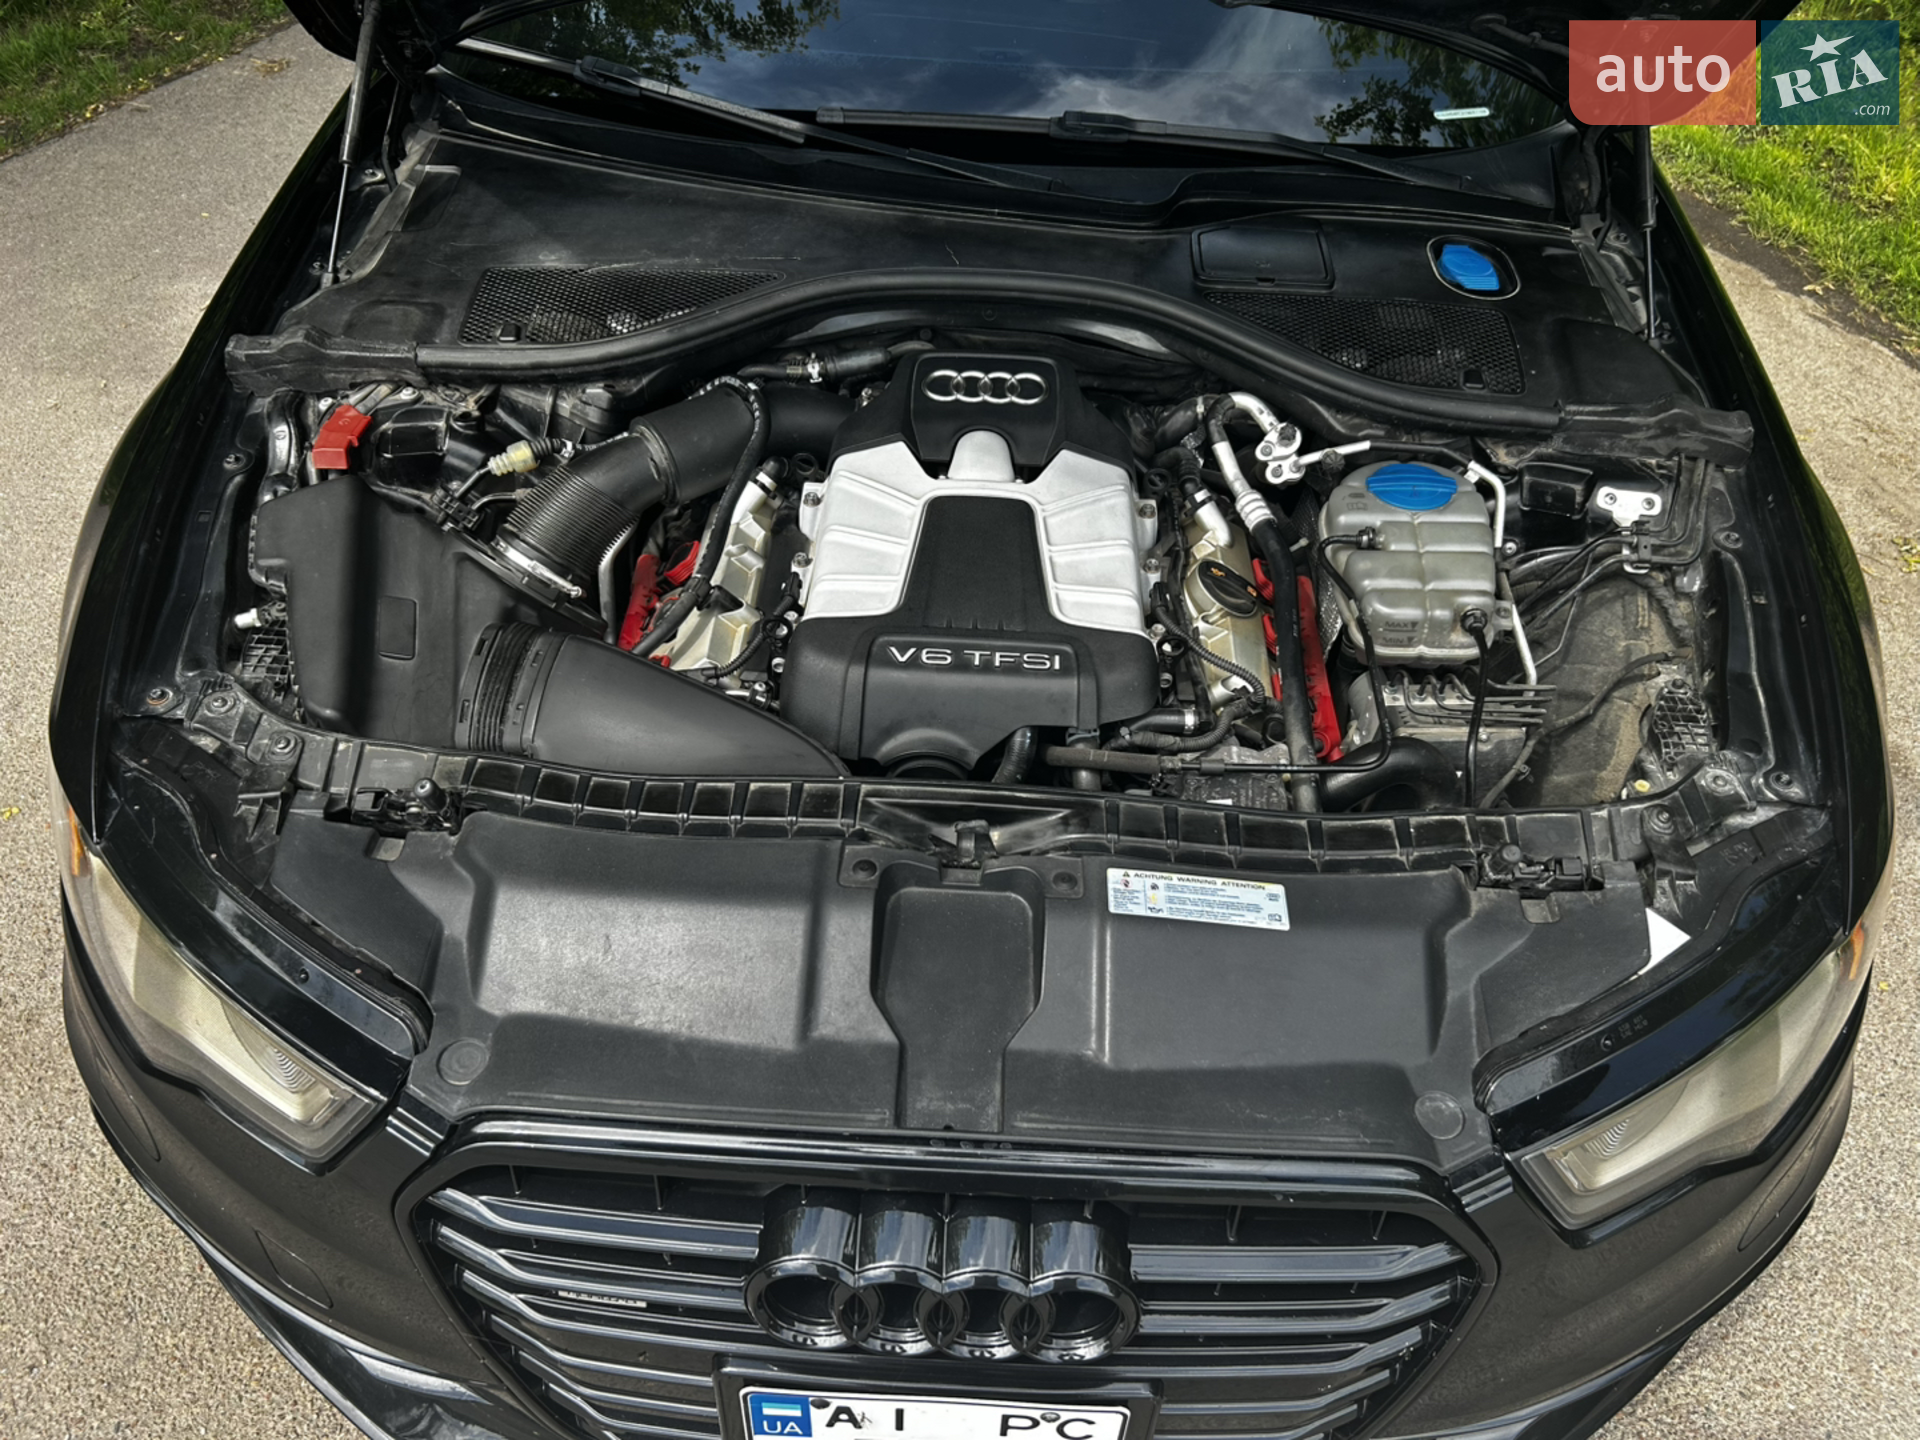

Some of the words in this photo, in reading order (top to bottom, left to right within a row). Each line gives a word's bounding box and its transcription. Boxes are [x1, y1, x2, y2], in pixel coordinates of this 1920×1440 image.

[1384, 620, 1409, 629] MAX
[1382, 636, 1405, 644] MIN
[888, 646, 953, 665] V6
[963, 649, 1061, 671] TFSI
[1133, 872, 1174, 882] ACHTUNG
[1177, 877, 1217, 887] WARNING
[1221, 880, 1266, 891] ATTENTION
[763, 1420, 804, 1435] UA
